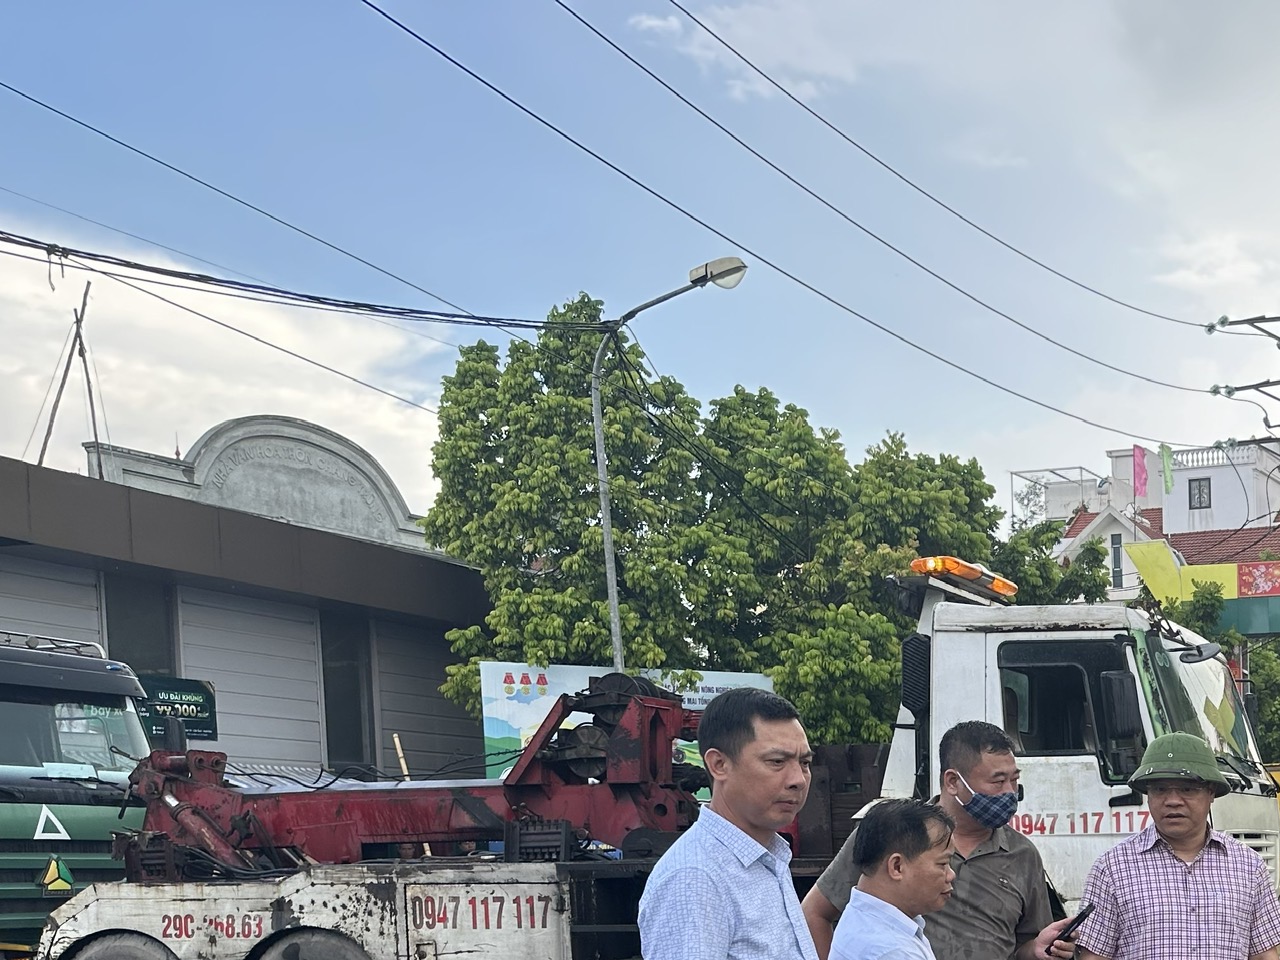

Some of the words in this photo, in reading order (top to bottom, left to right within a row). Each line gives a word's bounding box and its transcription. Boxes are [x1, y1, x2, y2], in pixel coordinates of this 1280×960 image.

[158, 692, 169, 700] ƯU
[1067, 812, 1104, 834] 117
[1112, 811, 1150, 833] 117
[411, 896, 460, 929] 0947
[468, 896, 504, 929] 117
[512, 895, 552, 929] 117
